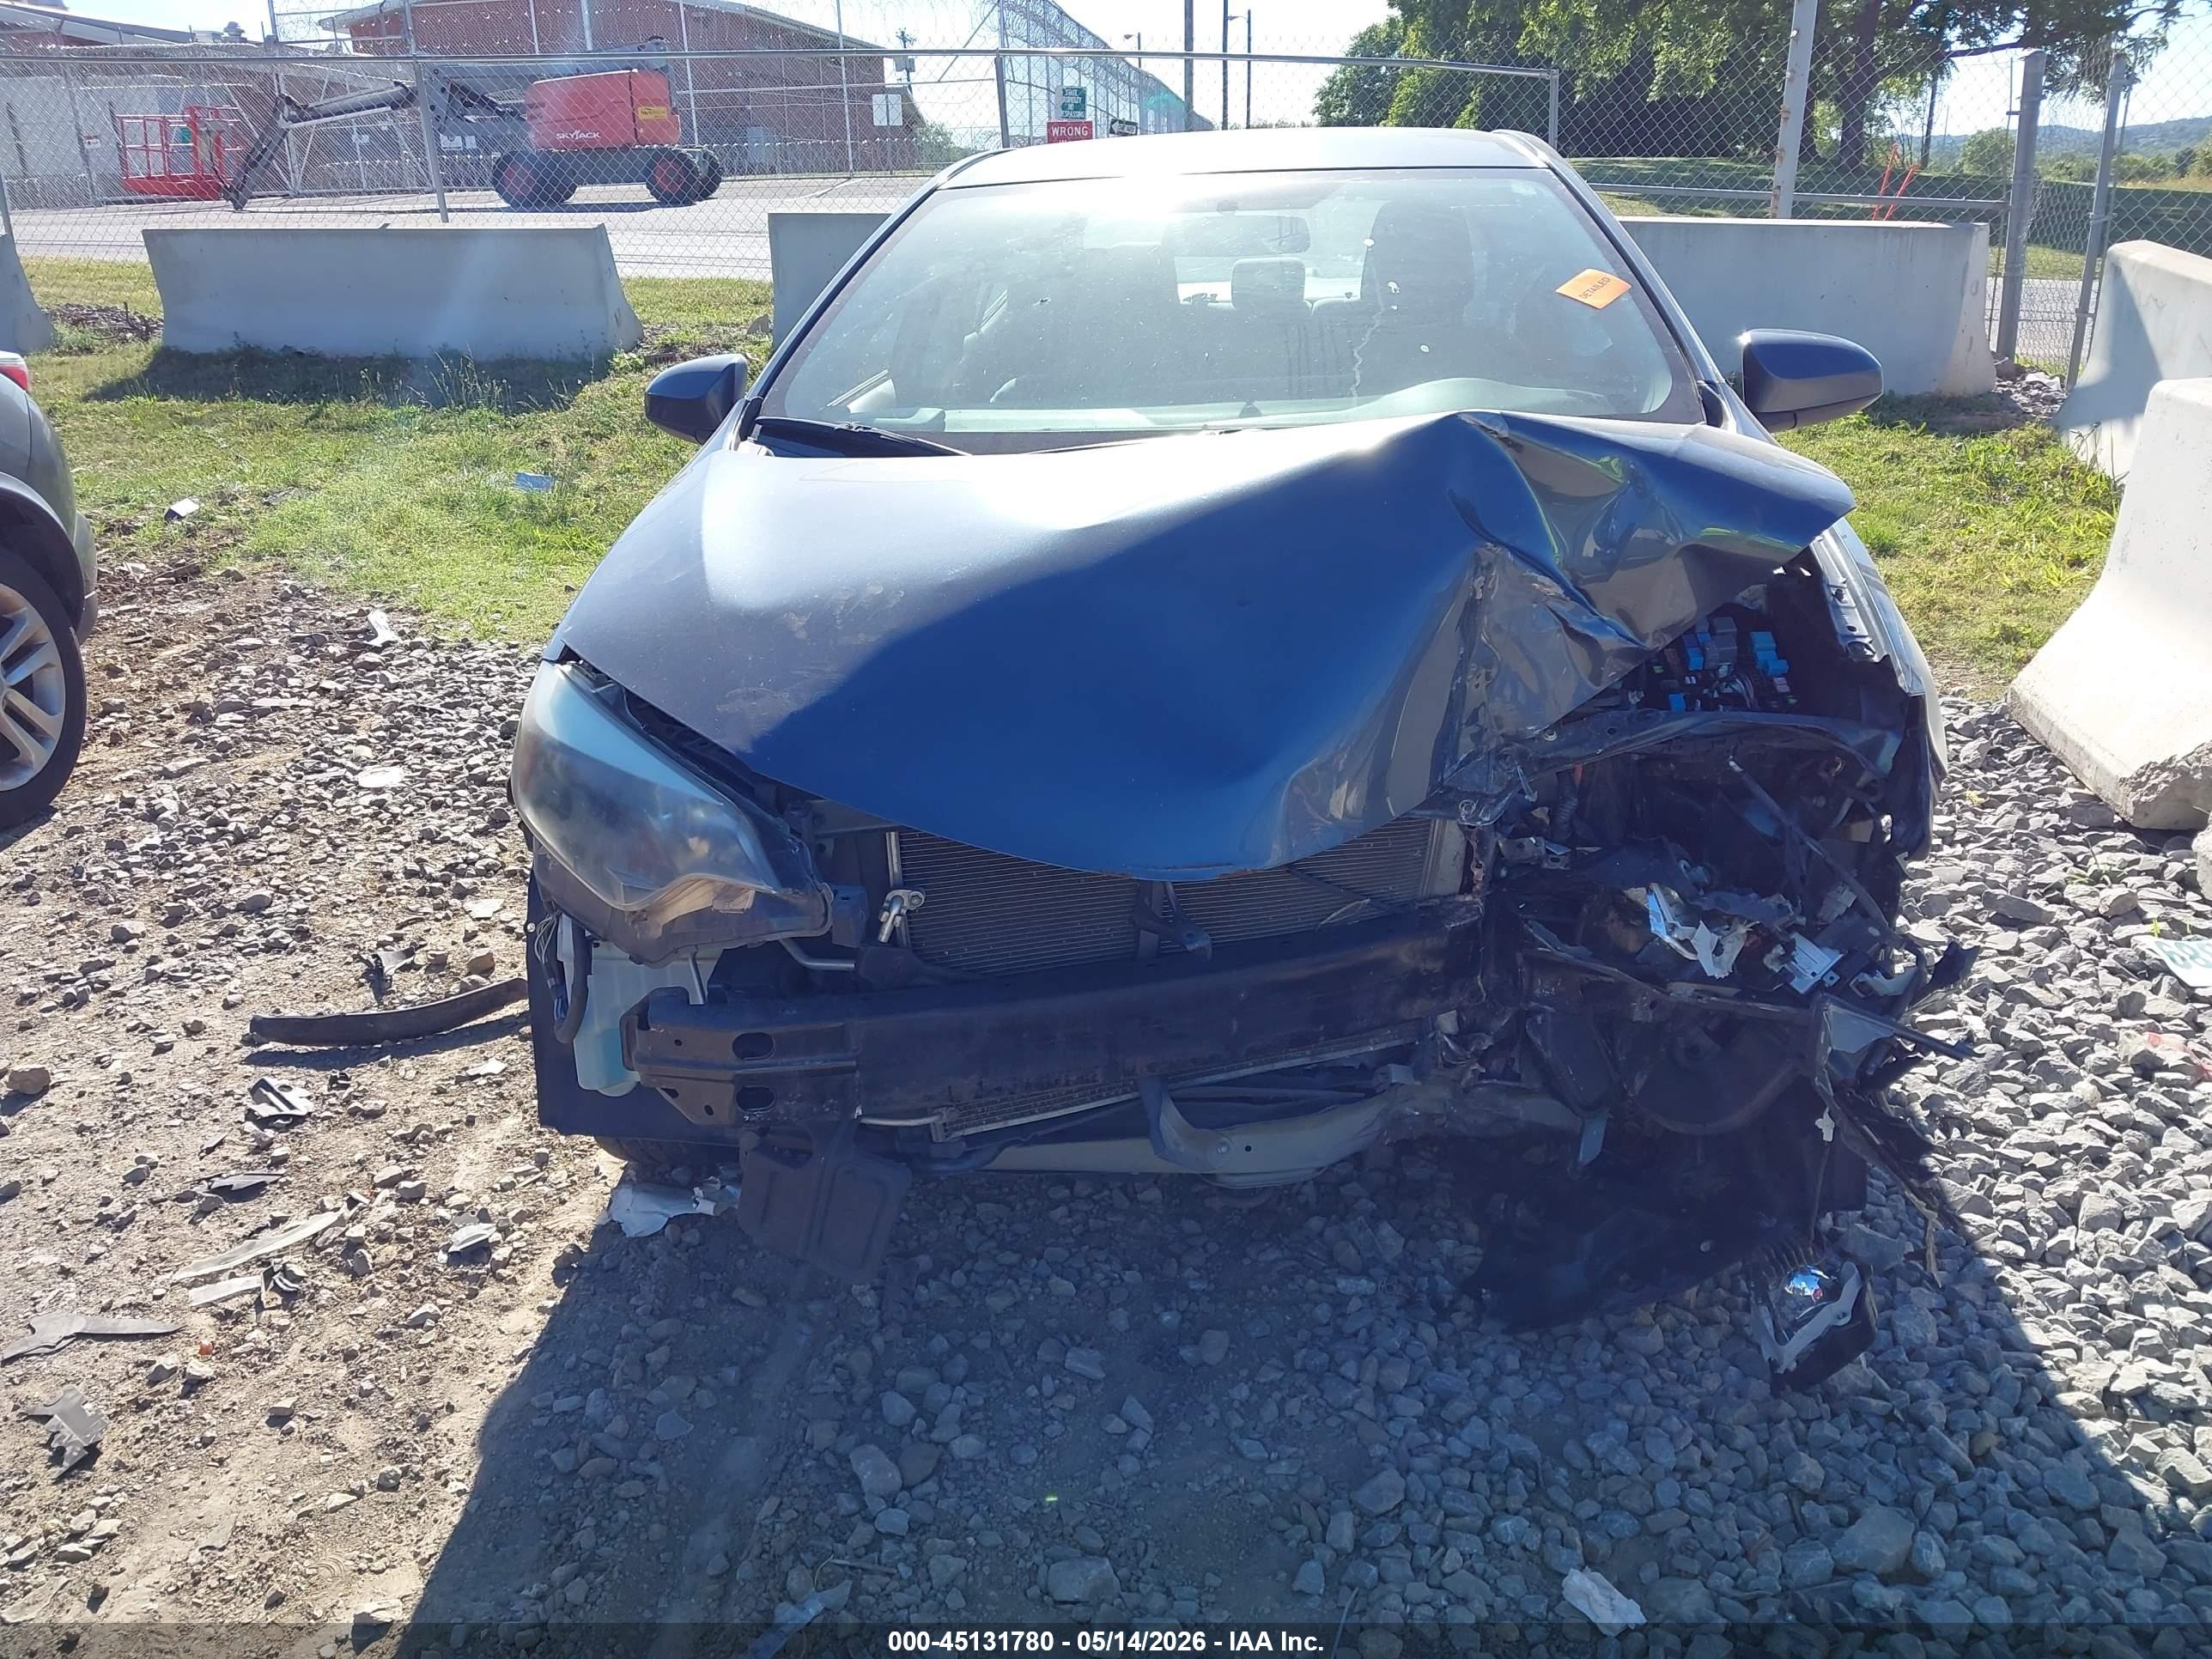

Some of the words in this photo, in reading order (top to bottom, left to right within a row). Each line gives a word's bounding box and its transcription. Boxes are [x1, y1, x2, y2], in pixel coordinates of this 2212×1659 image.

[556, 130, 601, 140] SKYJACK
[1051, 125, 1088, 137] WRONG
[1578, 276, 1611, 299] DETAILED
